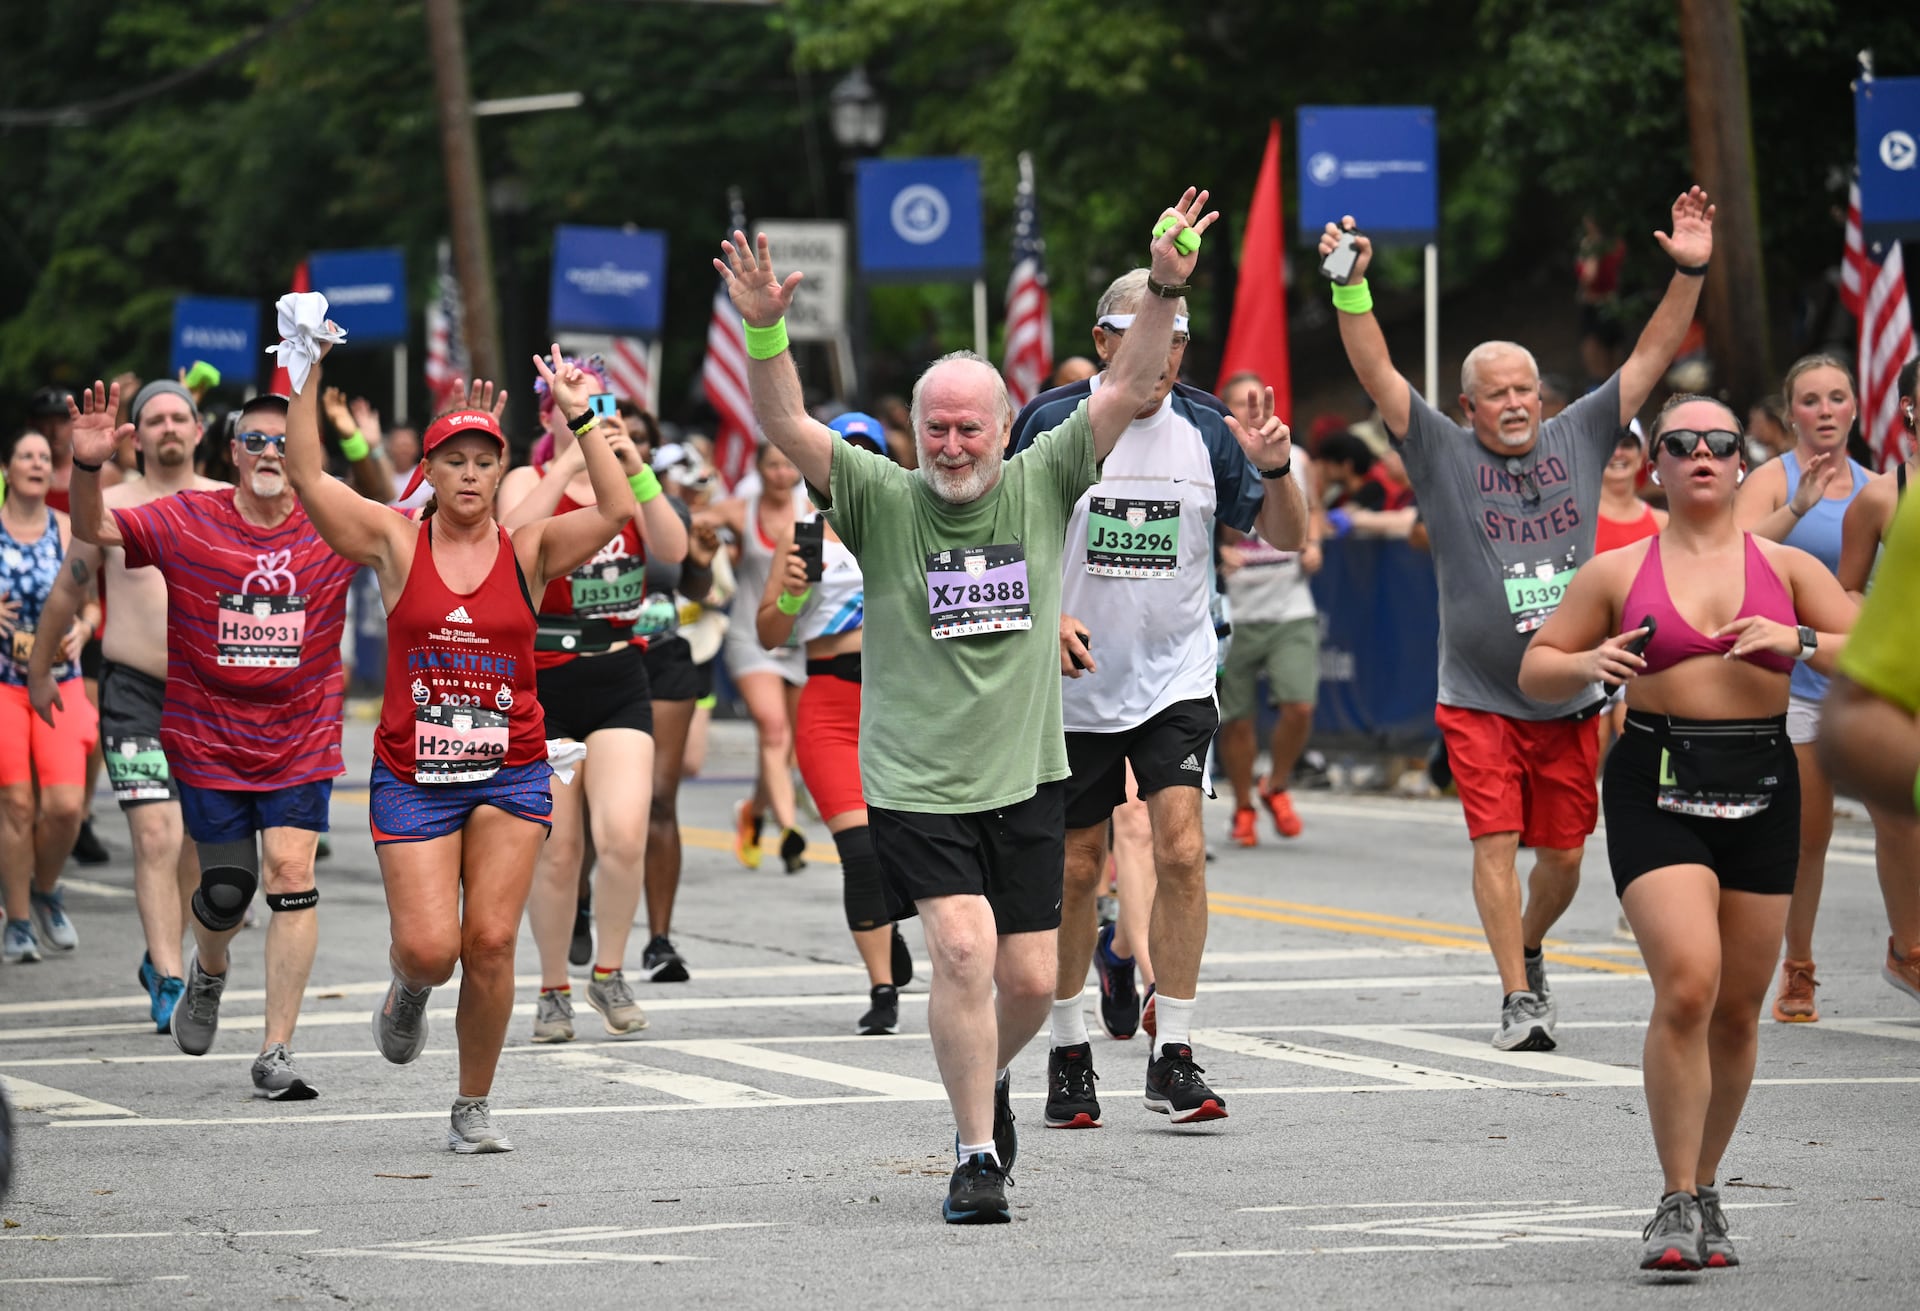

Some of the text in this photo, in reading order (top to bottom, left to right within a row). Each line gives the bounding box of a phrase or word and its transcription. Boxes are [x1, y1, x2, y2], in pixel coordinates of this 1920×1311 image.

[1485, 497, 1581, 544] STATES
[1092, 527, 1173, 551] J33296
[577, 581, 643, 605] J35197
[932, 581, 1025, 609] X78388
[445, 615, 473, 624] adidas
[222, 621, 298, 642] H30931
[408, 651, 517, 677] PEACHTREE
[432, 678, 492, 691] ROAD RACE
[440, 692, 482, 708] 2023
[1180, 763, 1202, 773] adidas
